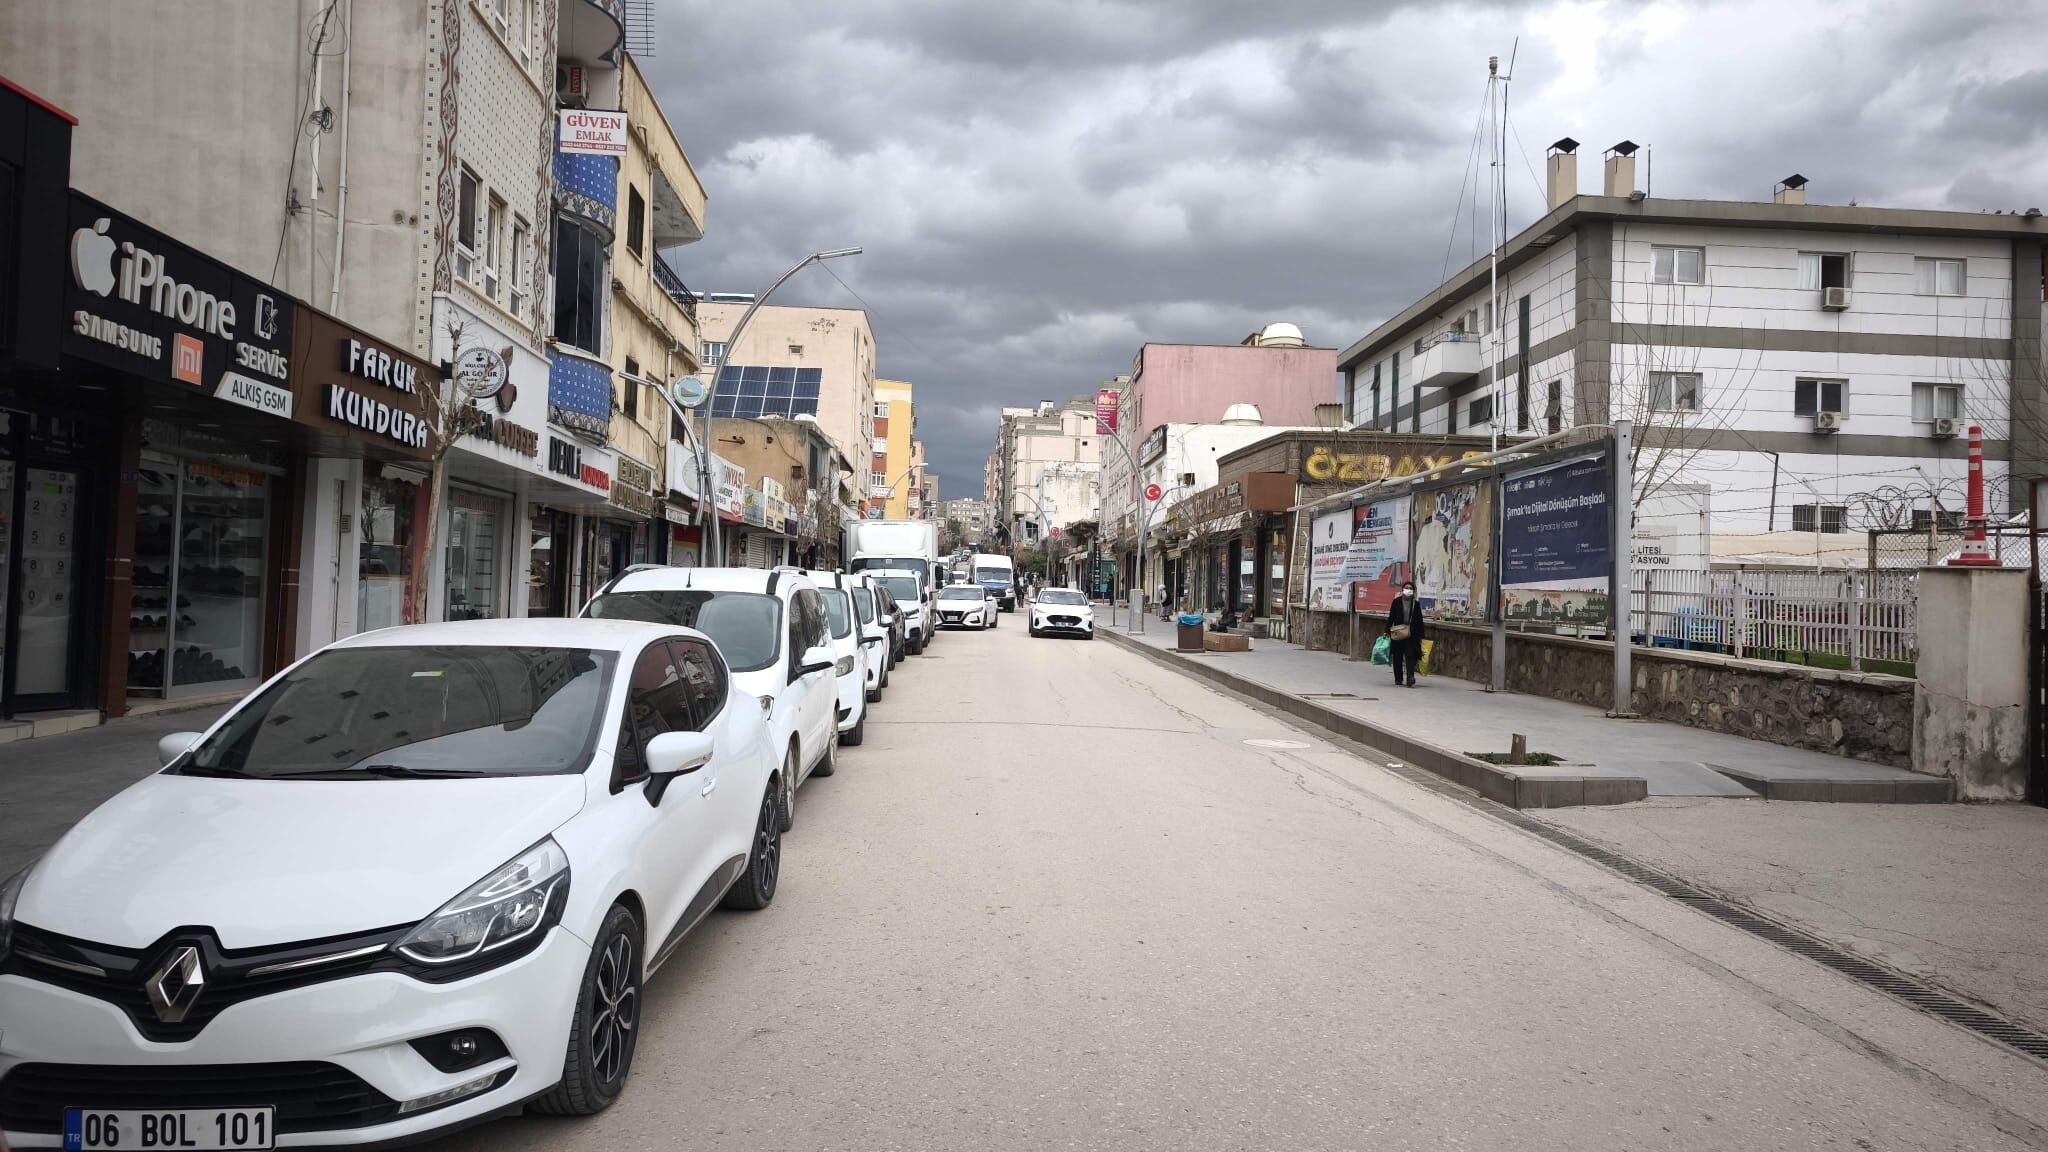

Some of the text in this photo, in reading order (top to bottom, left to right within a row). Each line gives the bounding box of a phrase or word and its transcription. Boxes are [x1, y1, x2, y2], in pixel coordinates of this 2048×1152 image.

[566, 112, 621, 130] GÜVEN
[576, 130, 612, 142] EMLAK
[119, 242, 236, 340] iPhone
[74, 310, 162, 360] SAMSUNG
[236, 342, 287, 380] SERVİS
[348, 338, 417, 395] FARUK
[231, 379, 286, 411] ALKIŞ GSM
[329, 384, 427, 448] KUNDURA
[33, 500, 67, 513] 2 3
[1507, 504, 1531, 520] Şırnak'ta
[1549, 495, 1579, 513] Dönüşüm
[1579, 491, 1606, 509] Başladı
[32, 530, 66, 542] 5 6
[30, 559, 64, 570] 8 9
[68, 1133, 80, 1143] TR
[85, 1111, 265, 1147] 06 BOL 101
